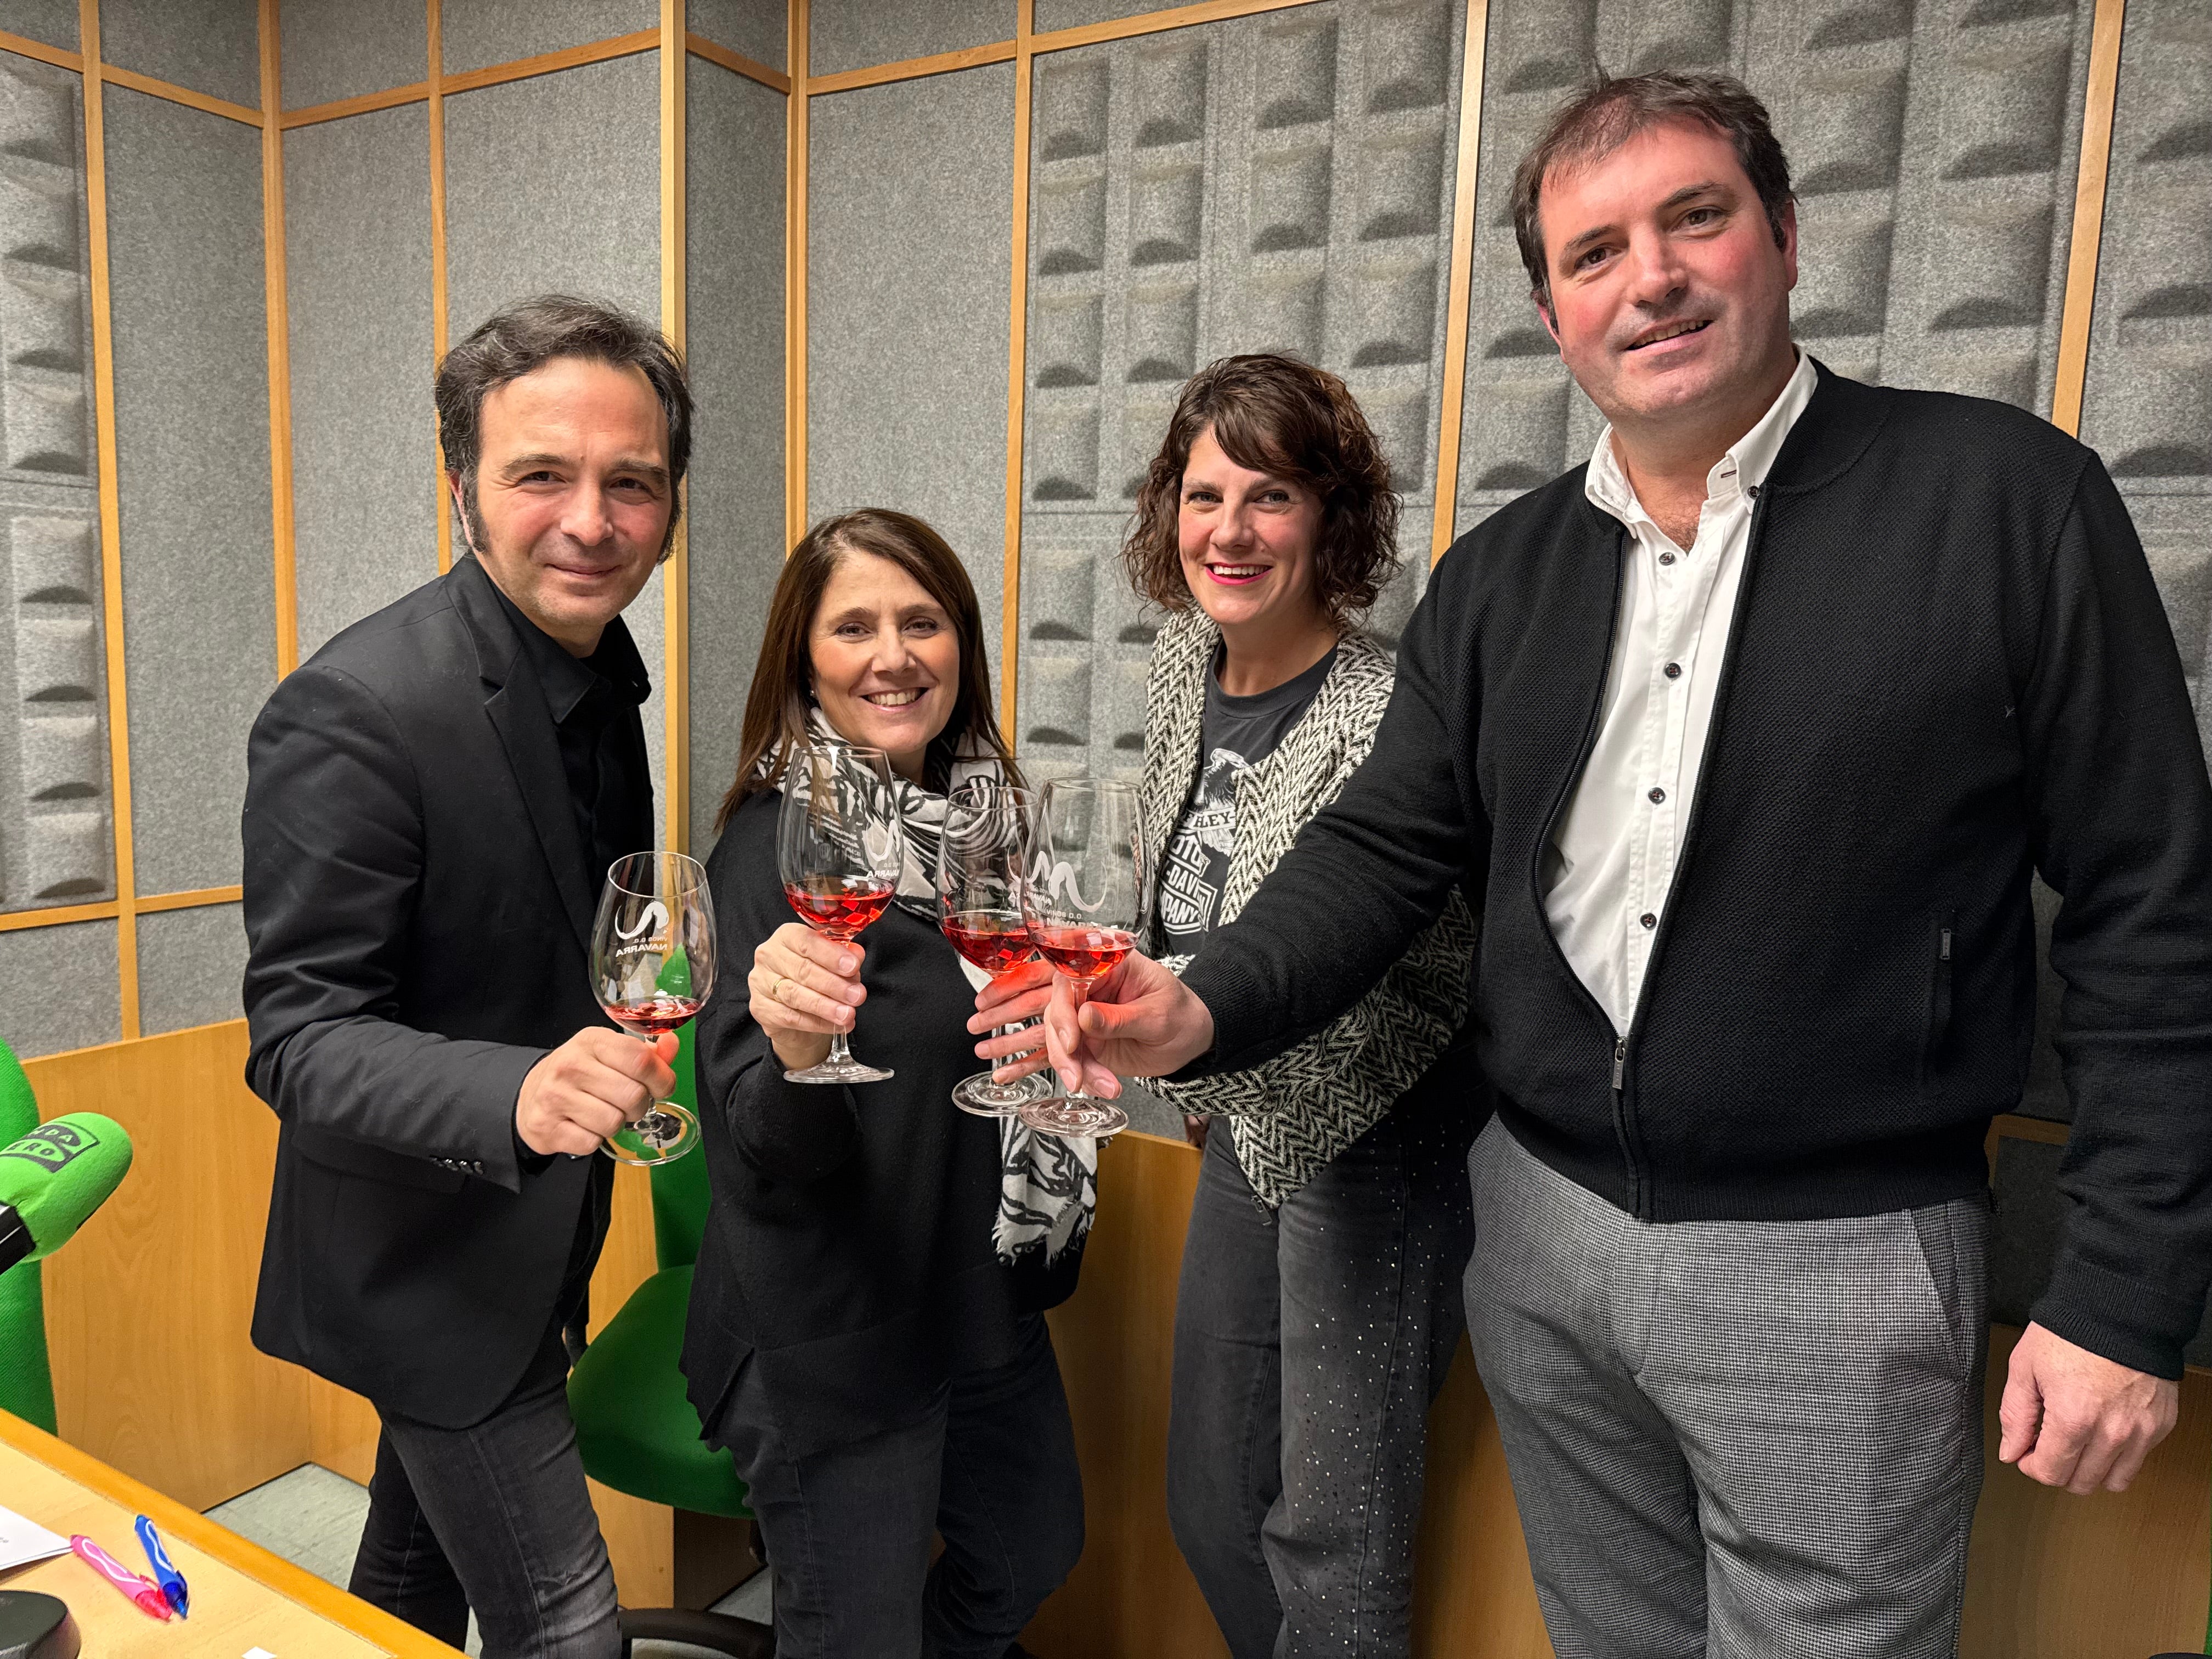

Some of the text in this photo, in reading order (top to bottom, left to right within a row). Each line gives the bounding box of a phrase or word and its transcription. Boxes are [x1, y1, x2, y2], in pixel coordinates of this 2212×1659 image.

[1169, 834, 1201, 867] OTO
[1159, 884, 1199, 924] MPANY
[29, 1128, 74, 1143] NDA
[6, 1141, 55, 1156] ERO
